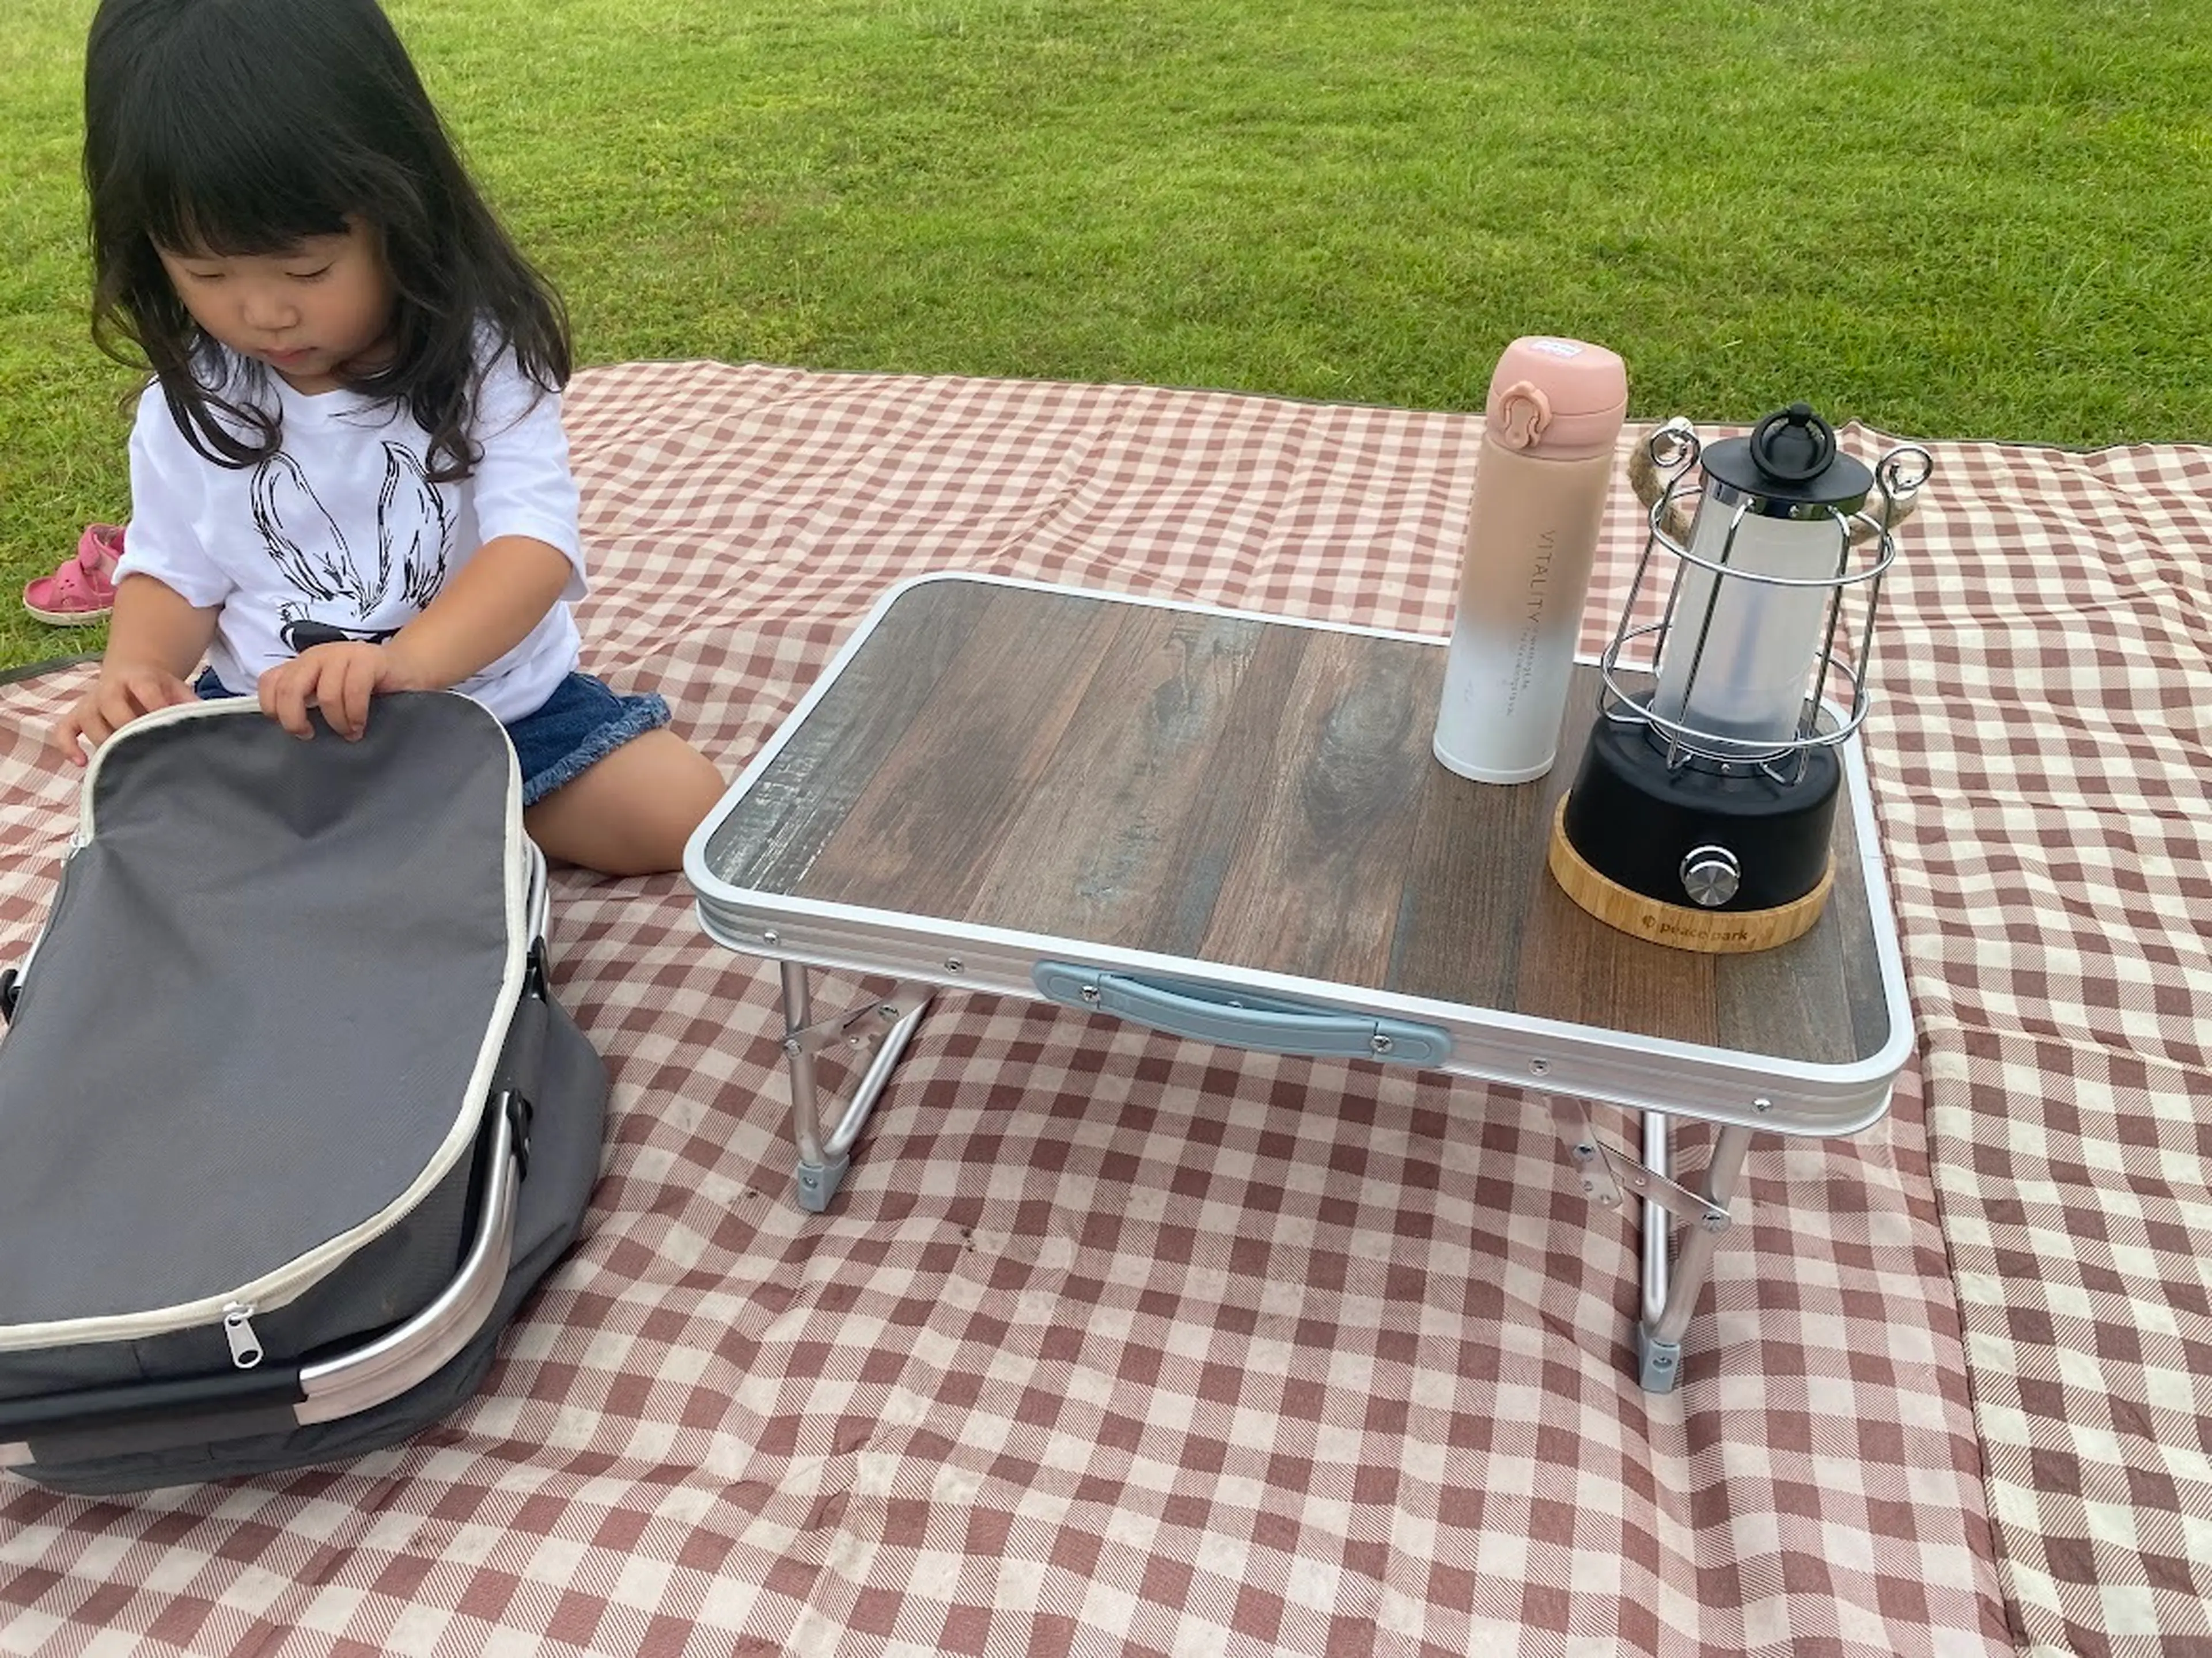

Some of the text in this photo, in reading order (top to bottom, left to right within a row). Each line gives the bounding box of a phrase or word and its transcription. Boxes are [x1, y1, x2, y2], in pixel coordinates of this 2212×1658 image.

[1527, 529, 1555, 623] VITALITY
[1660, 923, 1748, 942] peace park
